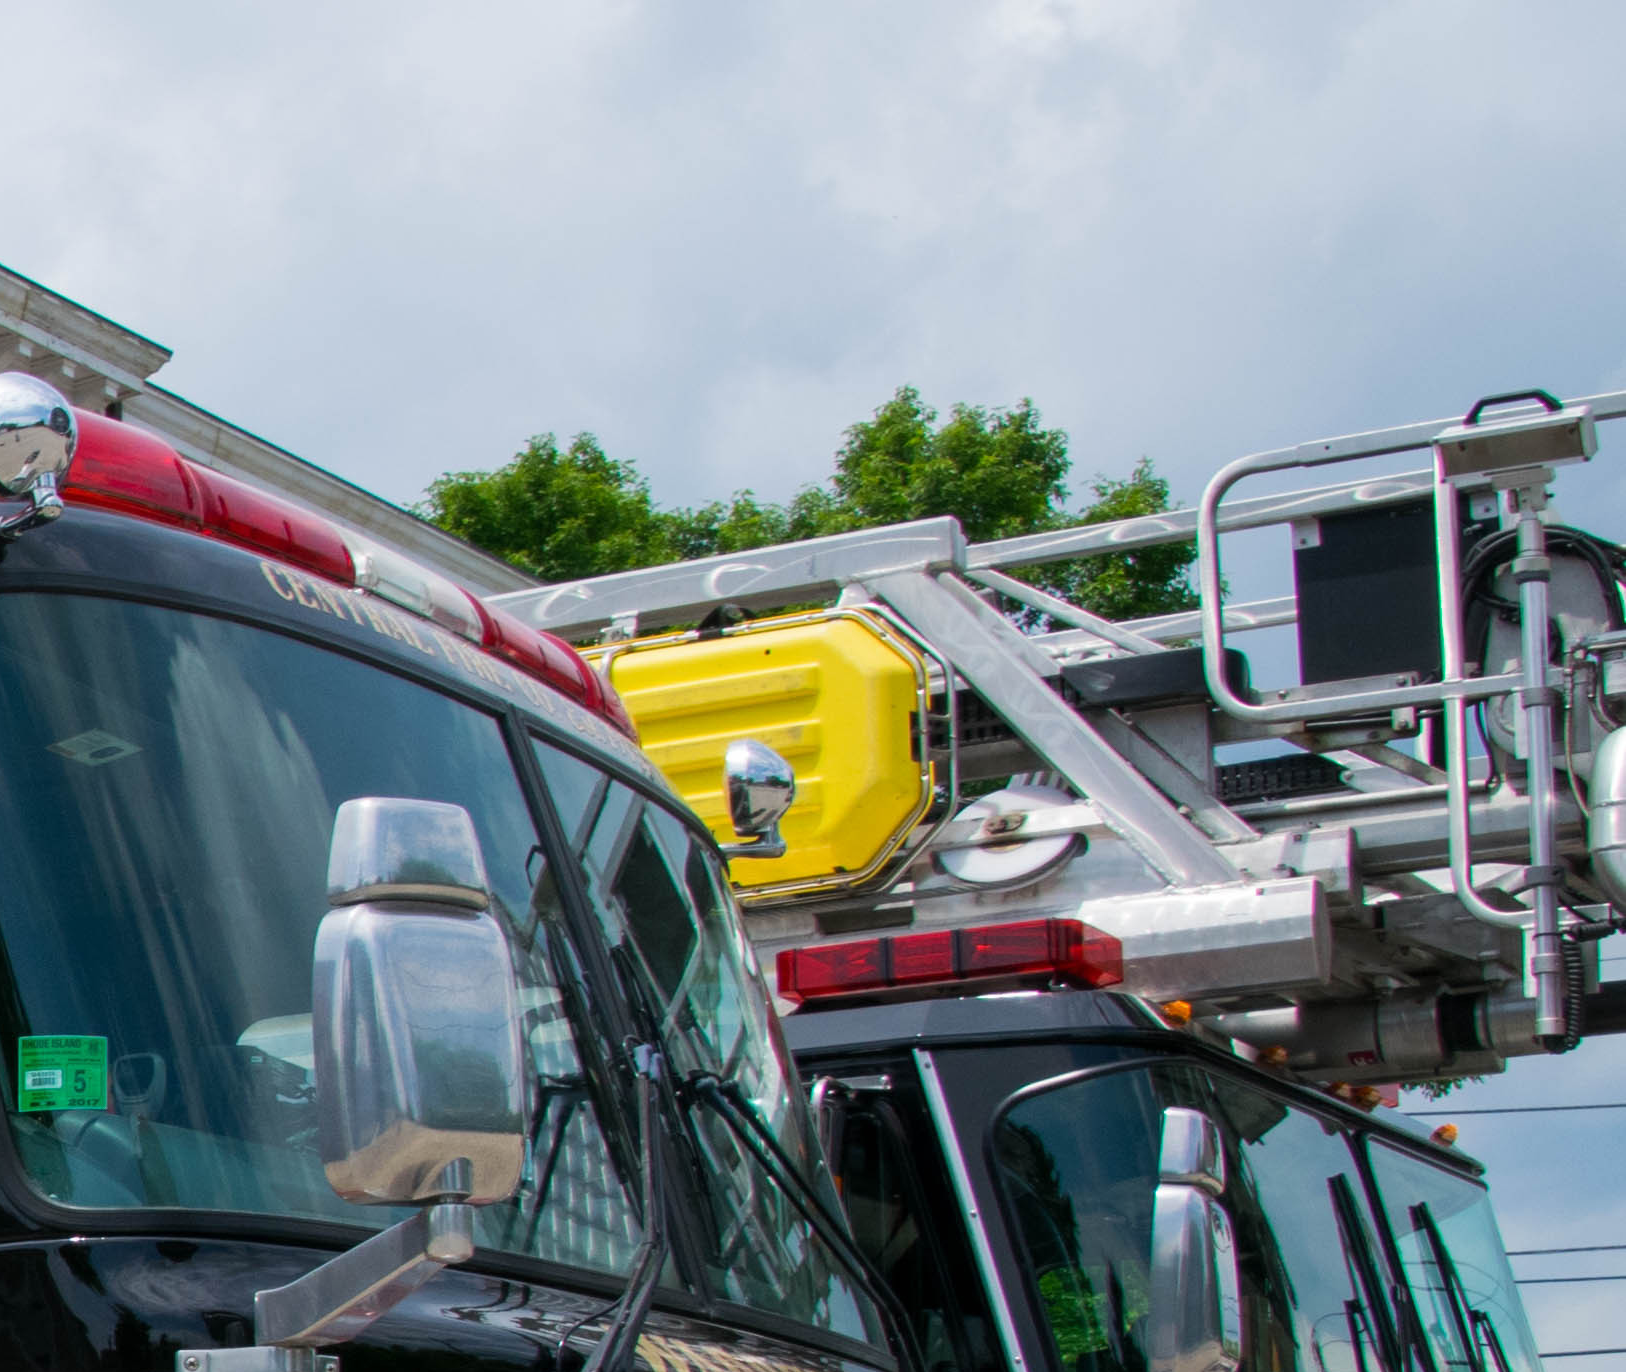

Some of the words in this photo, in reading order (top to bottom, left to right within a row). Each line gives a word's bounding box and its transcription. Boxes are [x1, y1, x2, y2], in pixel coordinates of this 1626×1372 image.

[259, 558, 436, 657] CENTRAL
[73, 1069, 86, 1093] 5
[67, 1098, 100, 1106] 2017
